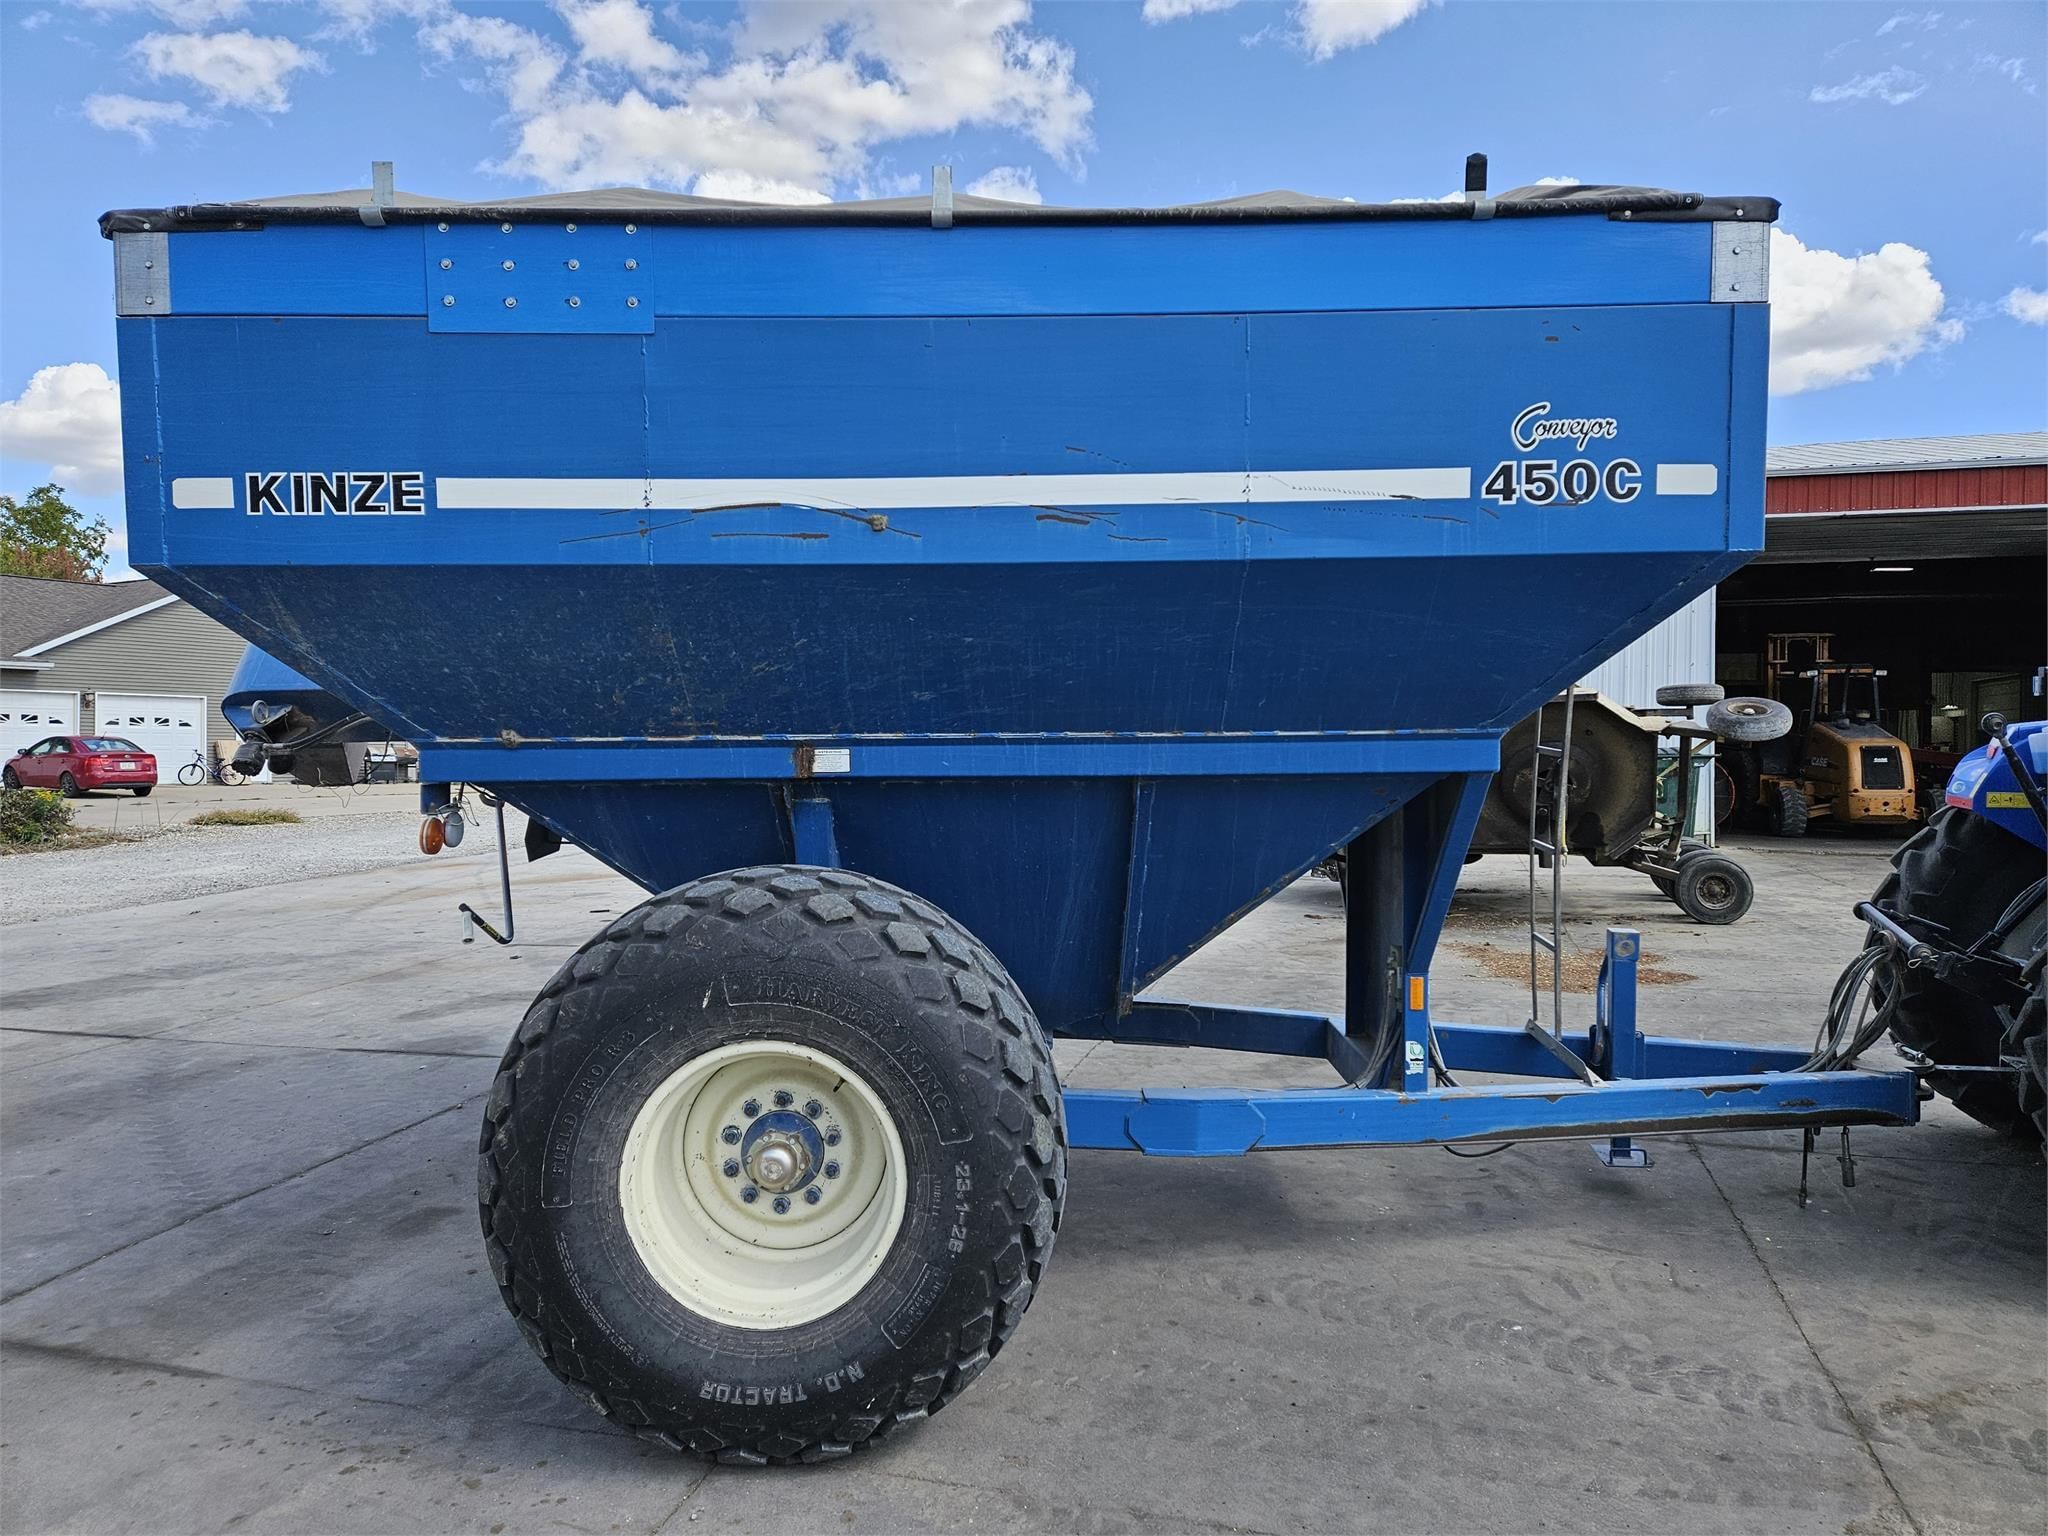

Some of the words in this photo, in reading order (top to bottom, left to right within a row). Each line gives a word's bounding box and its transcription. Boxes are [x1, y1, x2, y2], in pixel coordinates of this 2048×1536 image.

[1511, 402, 1617, 452] Conveyor
[245, 471, 426, 516] KINZE
[1481, 458, 1643, 506] 450C
[889, 1038, 952, 1111] KING
[552, 1112, 578, 1178] FIELD
[572, 1065, 605, 1105] PRO
[948, 1164, 972, 1253] 23.1-26
[698, 1379, 808, 1406] TRACTOR
